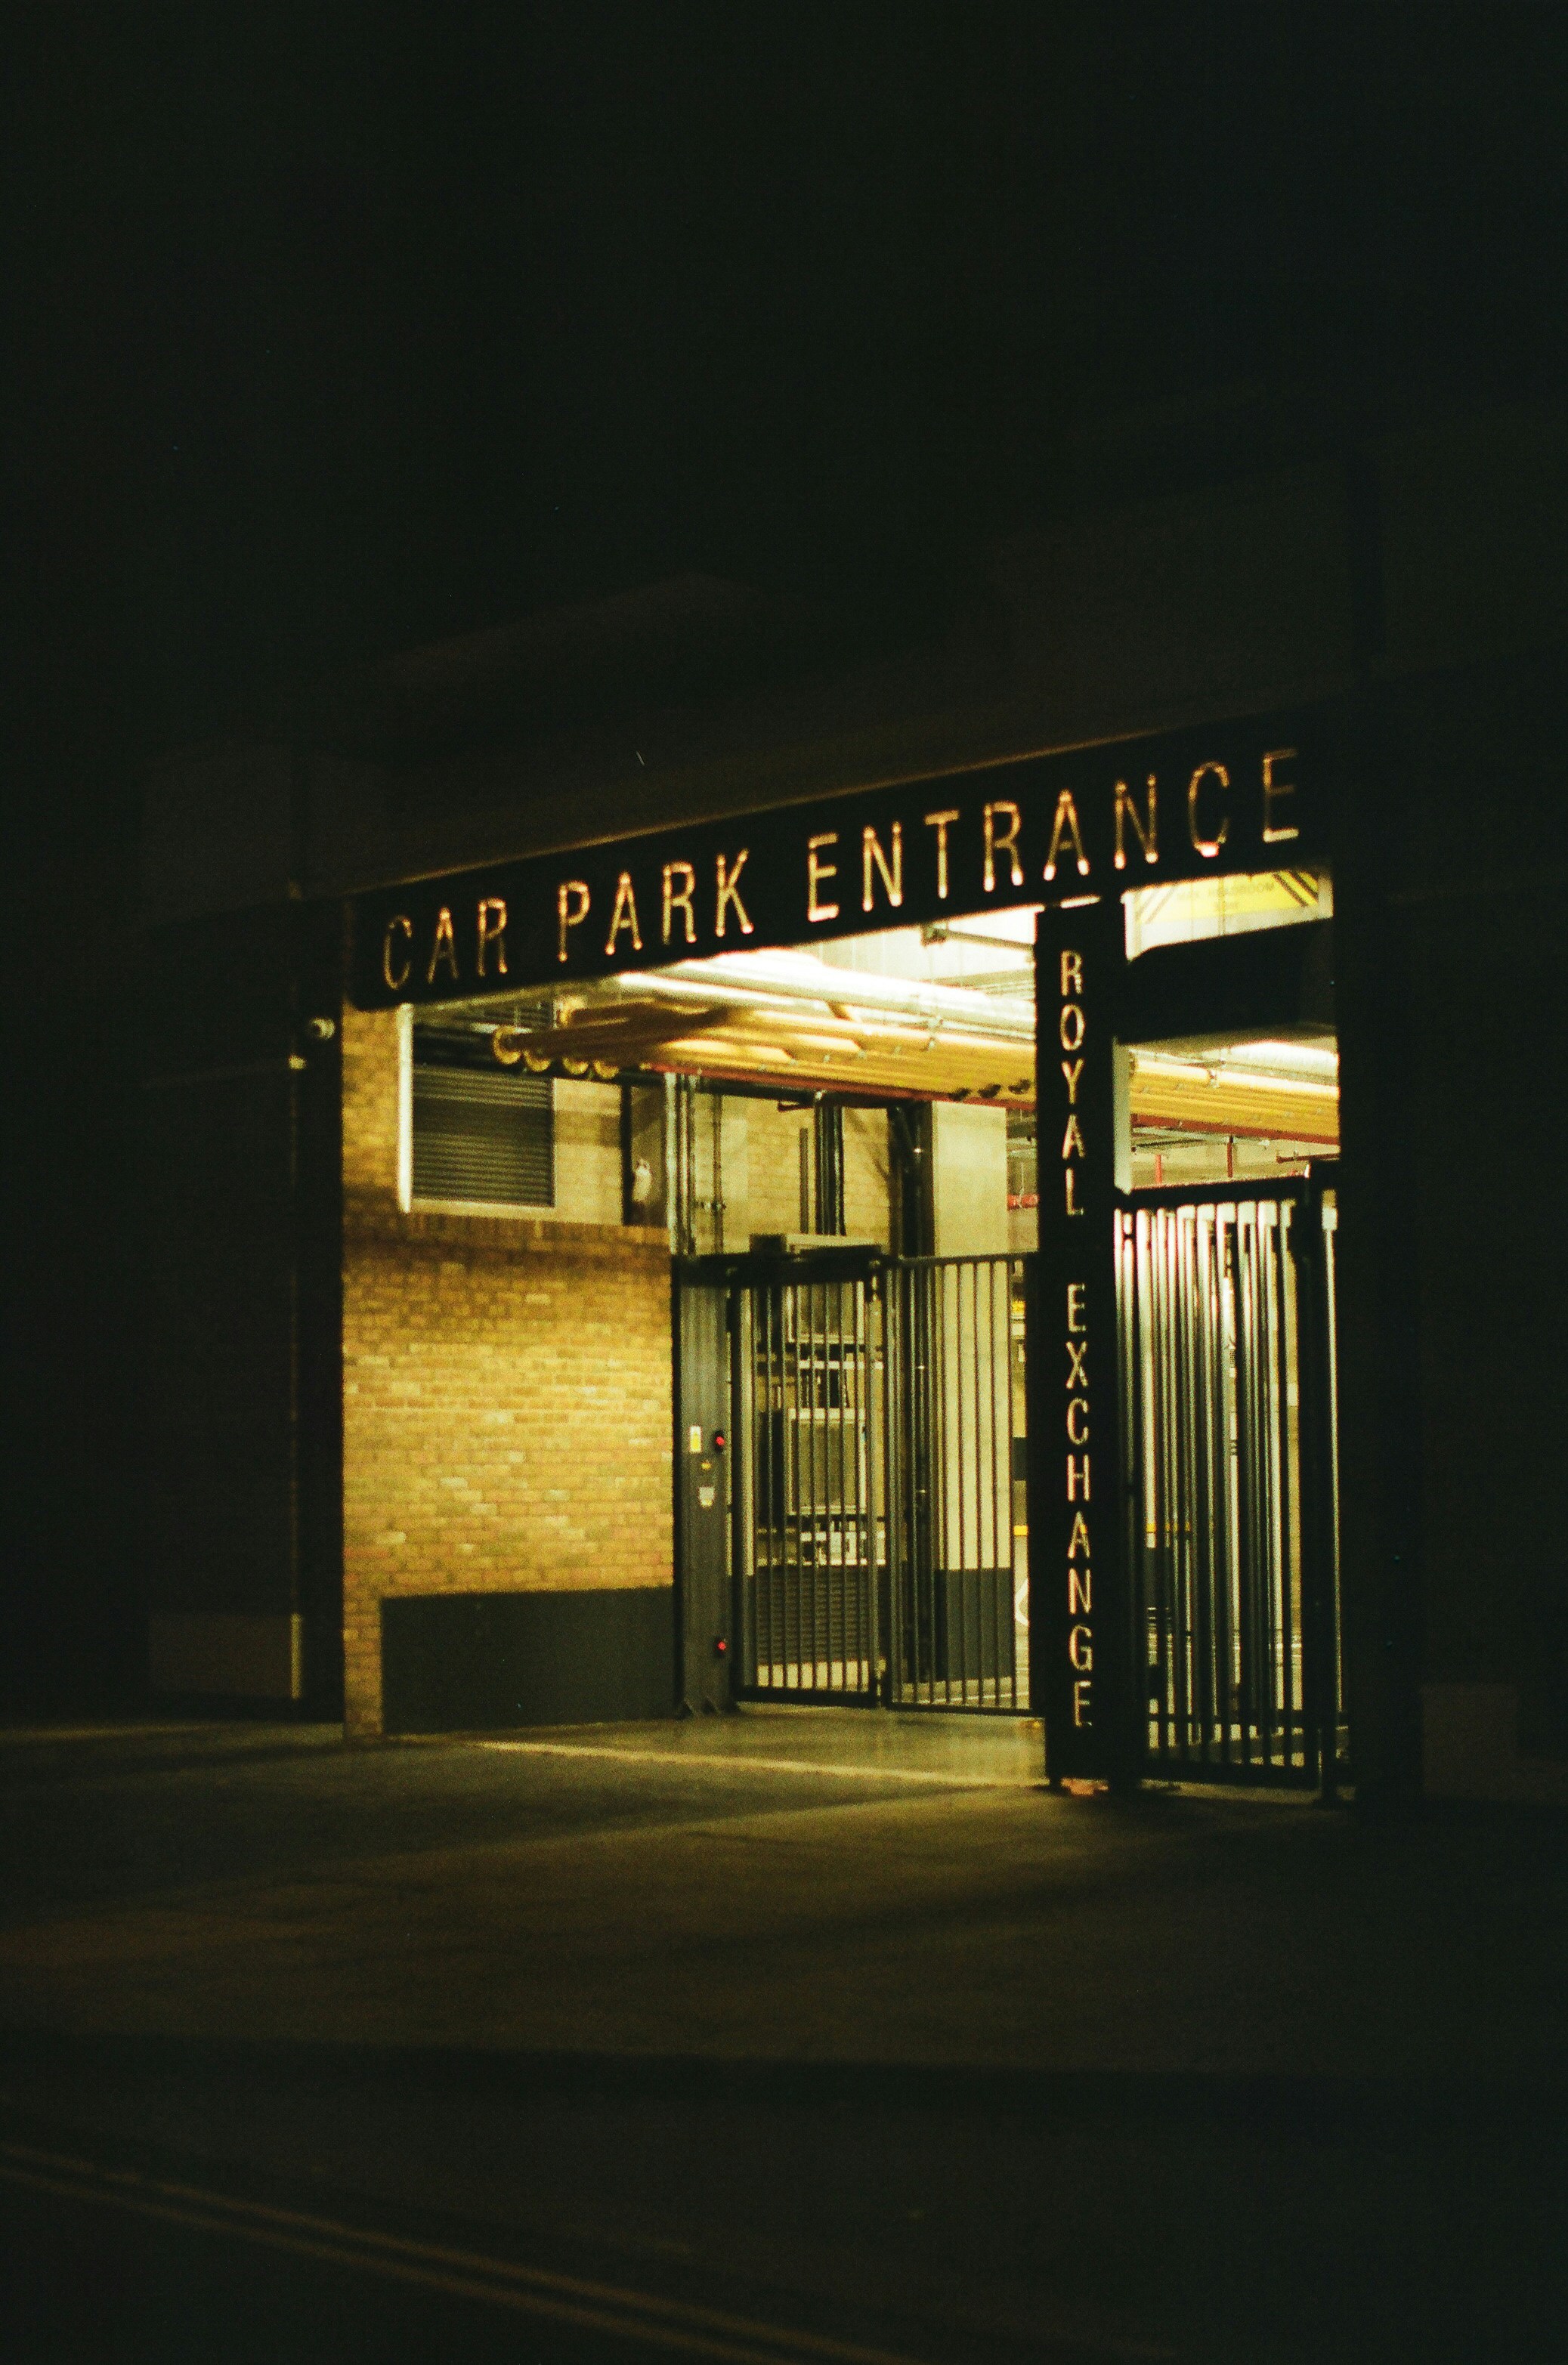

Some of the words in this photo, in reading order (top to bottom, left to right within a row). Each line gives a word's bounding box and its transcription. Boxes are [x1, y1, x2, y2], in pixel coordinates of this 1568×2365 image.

[384, 897, 509, 991] CAR
[558, 847, 754, 963] PARK
[807, 749, 1299, 923] ENTRANCE
[1060, 949, 1086, 1216] ROYAL
[1065, 1283, 1093, 1728] EXCHANGE
